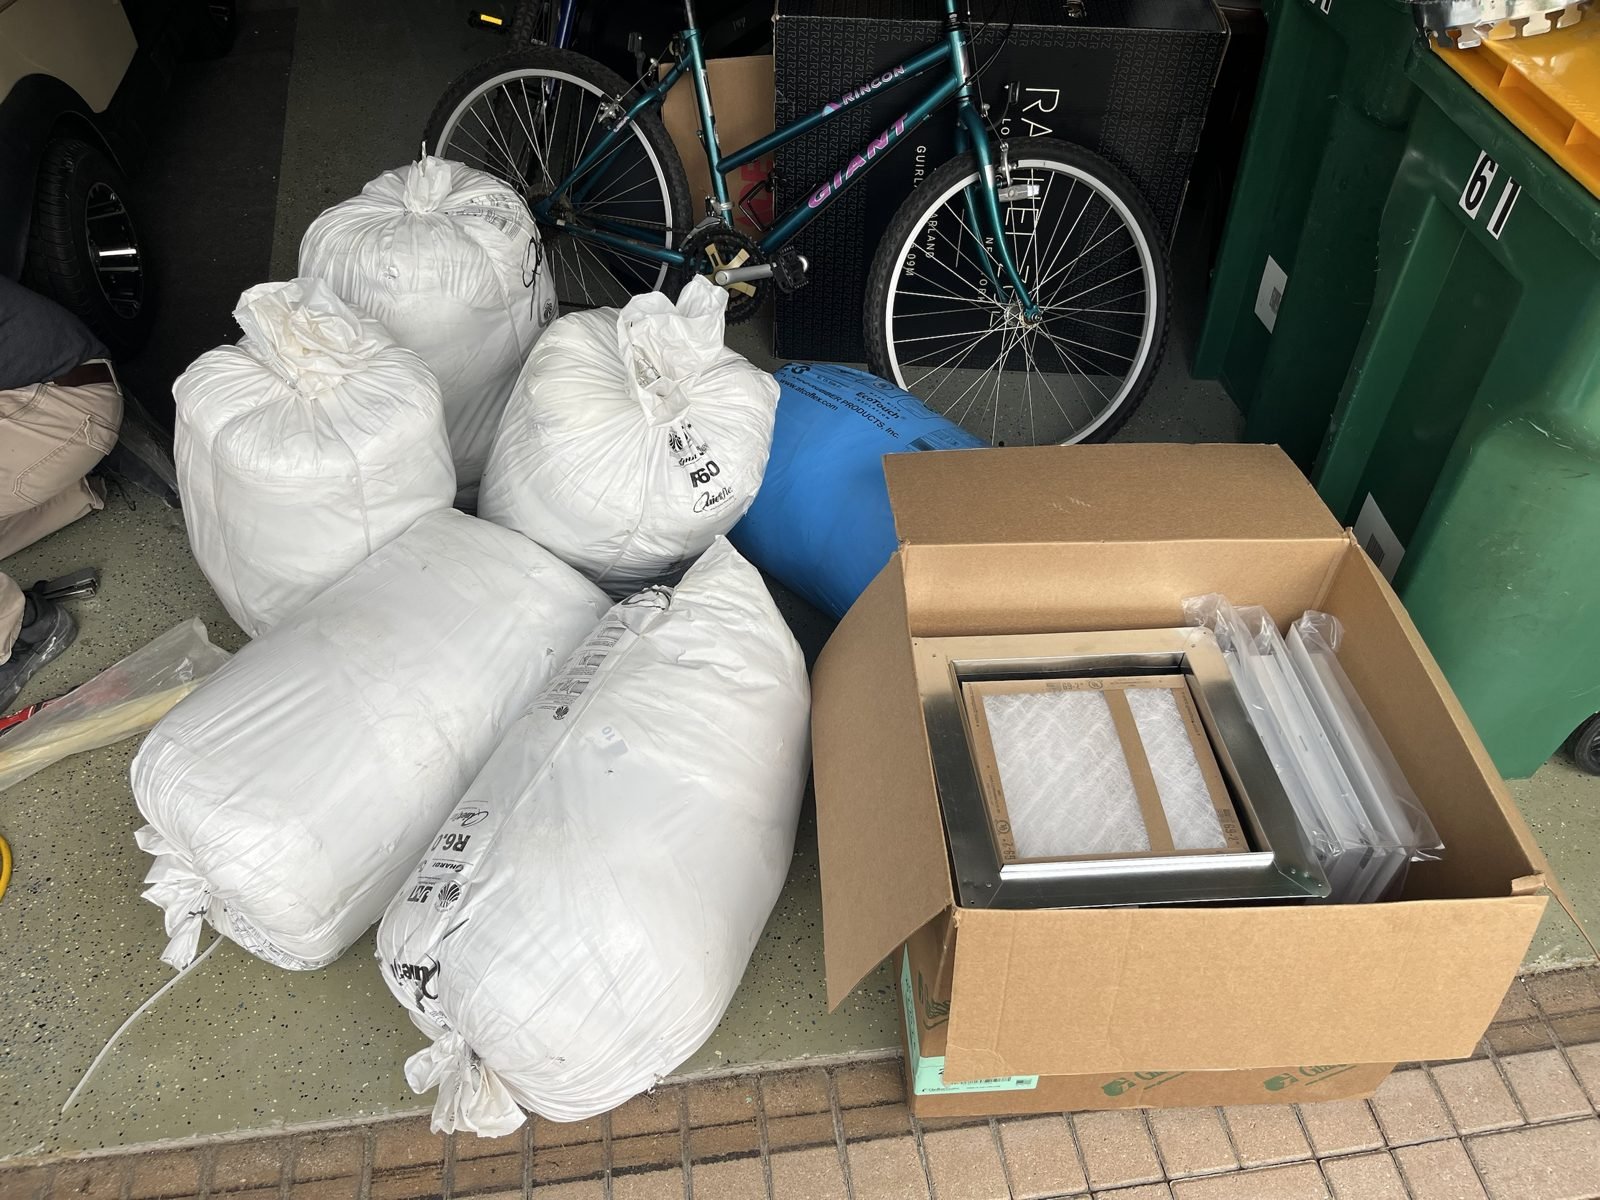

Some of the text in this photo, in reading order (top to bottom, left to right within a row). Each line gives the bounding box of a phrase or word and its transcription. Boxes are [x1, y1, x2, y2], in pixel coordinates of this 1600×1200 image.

[841, 64, 905, 106] RINCON
[806, 113, 909, 209] GIANT
[913, 145, 927, 189] GUIRL
[1464, 155, 1521, 235] 61
[925, 211, 938, 259] ARLAND
[856, 391, 901, 420] EcoTouch
